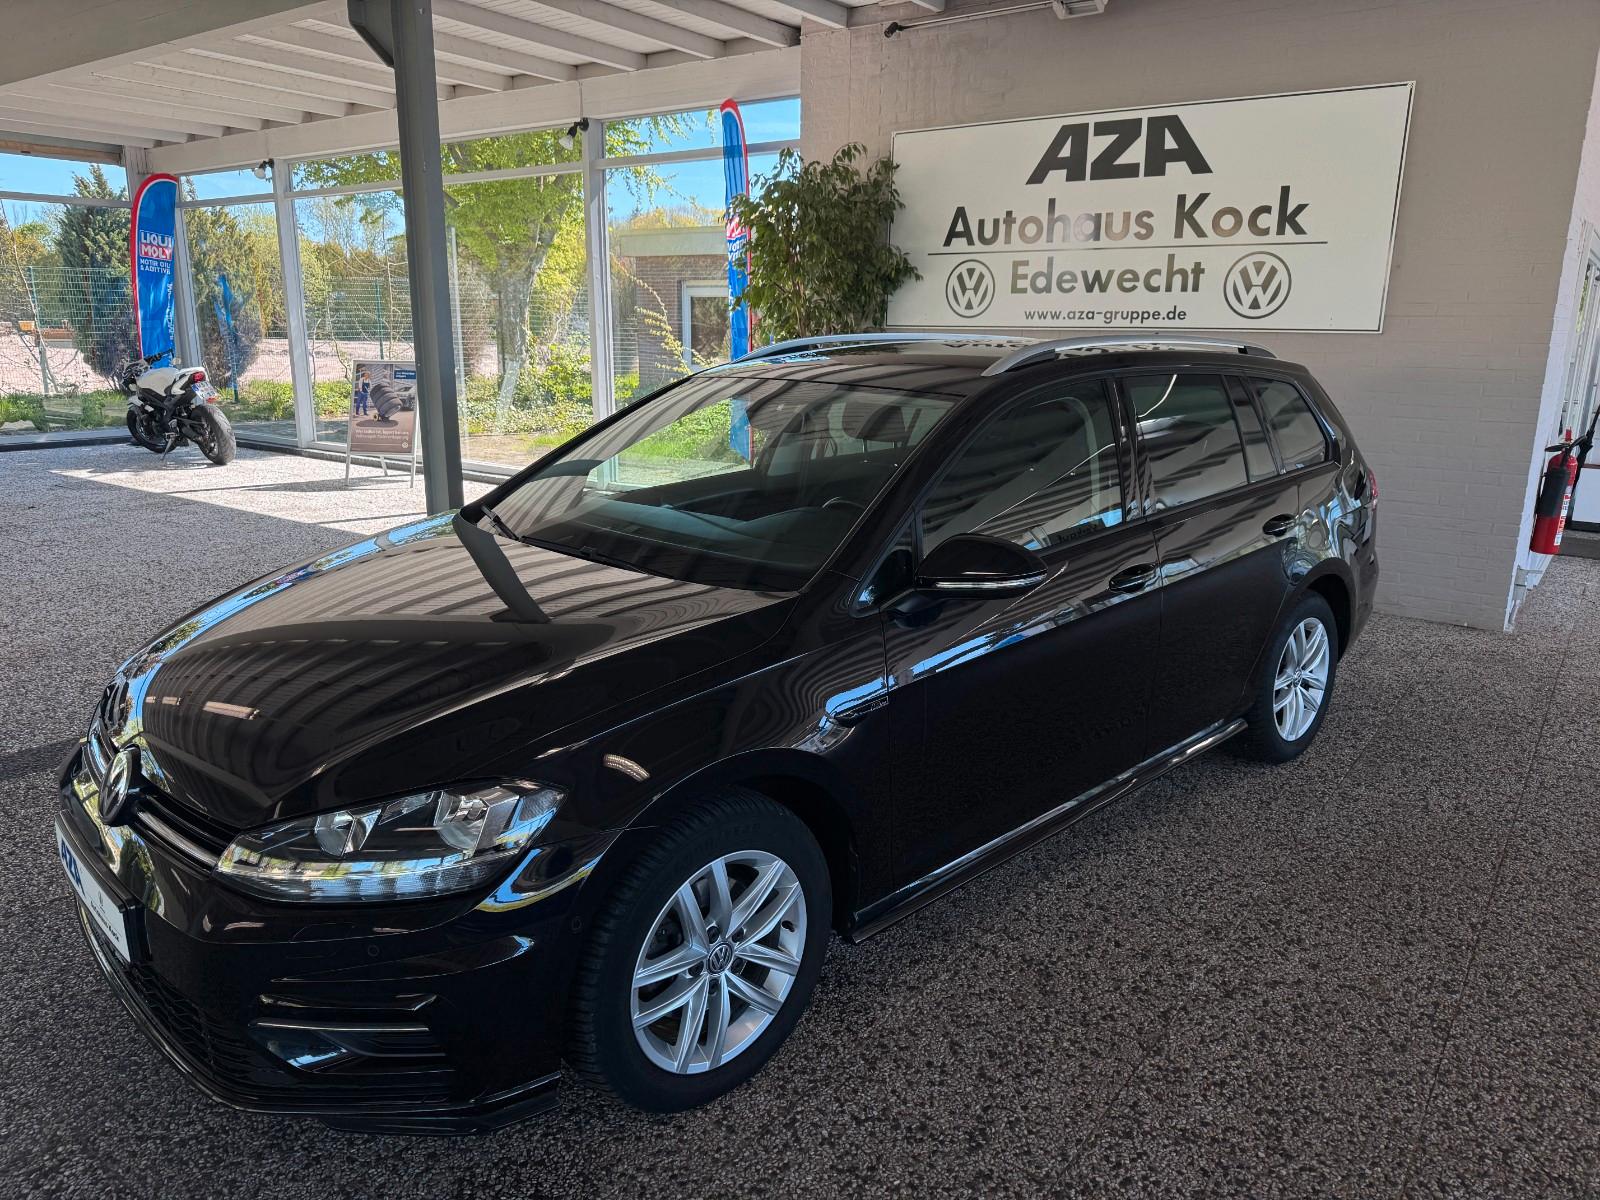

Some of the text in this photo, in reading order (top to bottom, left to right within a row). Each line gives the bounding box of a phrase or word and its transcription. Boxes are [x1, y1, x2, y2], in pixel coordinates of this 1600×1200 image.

[1025, 114, 1213, 185] AZA
[942, 185, 1310, 248] Autohaus Kock
[141, 231, 172, 248] LIQUI
[141, 244, 172, 260] MOLY
[1010, 253, 1206, 295] Edewecht
[1024, 305, 1187, 322] www.aza-gruppe.de
